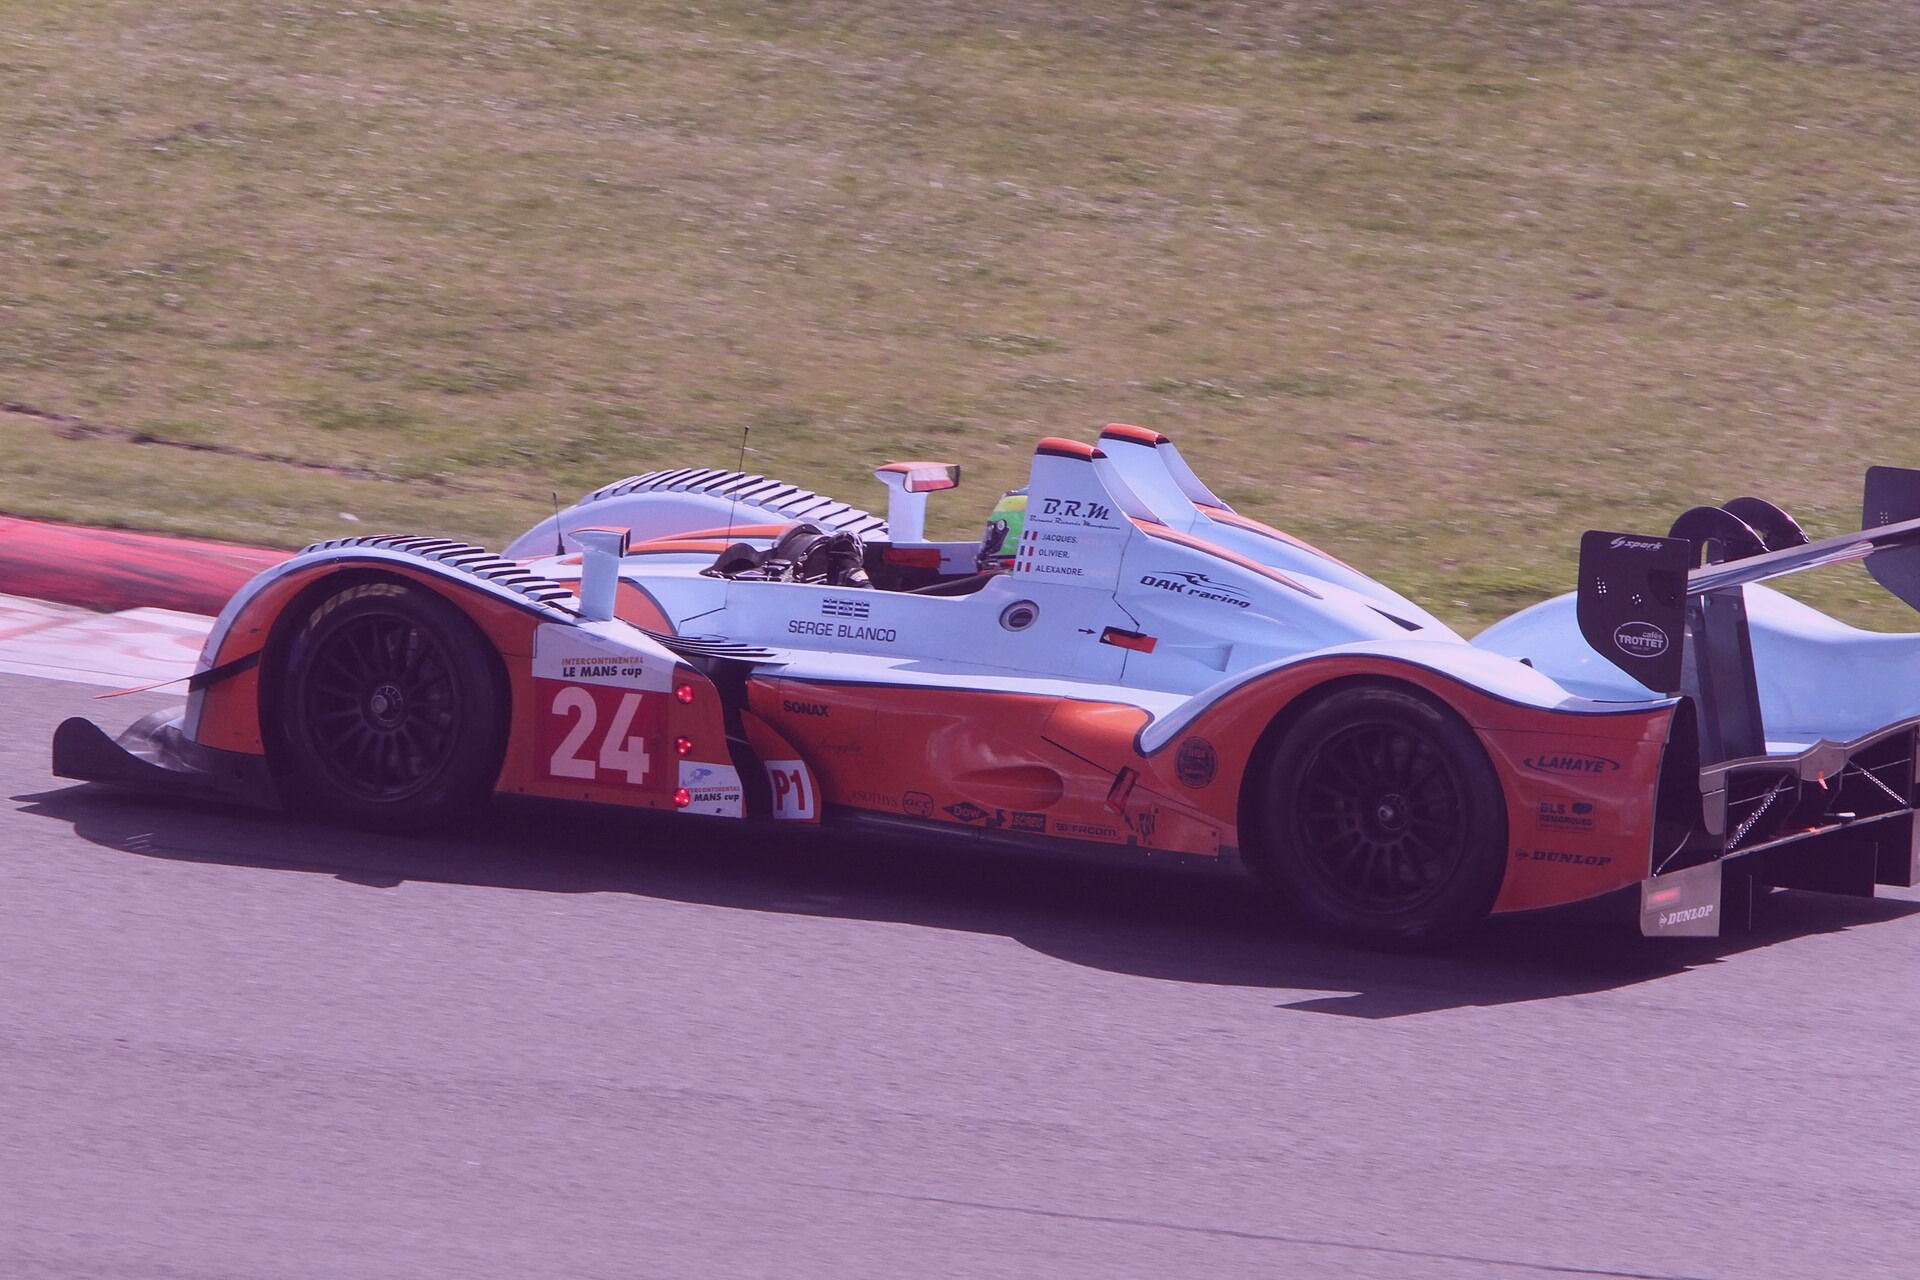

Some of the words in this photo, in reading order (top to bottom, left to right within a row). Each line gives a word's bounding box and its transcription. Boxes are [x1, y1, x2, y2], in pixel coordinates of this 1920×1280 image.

[1041, 534, 1078, 544] JACQUES.
[1038, 549, 1070, 559] OLIVIER.
[1035, 565, 1085, 577] ALEXANDRE.
[1188, 589, 1251, 608] racing
[788, 620, 834, 636] SERGE
[837, 625, 897, 642] BLANCO
[1618, 634, 1664, 649] TROTTET
[561, 657, 644, 666] INTERCONTINENTAL
[562, 667, 576, 678] LE
[580, 666, 618, 677] MANS
[621, 668, 643, 678] cup
[783, 700, 829, 717] SONAX
[550, 686, 650, 784] 24
[1537, 756, 1607, 773] LAHAYE
[694, 793, 722, 802] MANS
[724, 794, 740, 802] cup
[771, 769, 806, 811] P1
[1540, 802, 1566, 815] BLS
[1531, 850, 1612, 866] DUNLOP
[1667, 905, 1714, 926] DUNLOP
